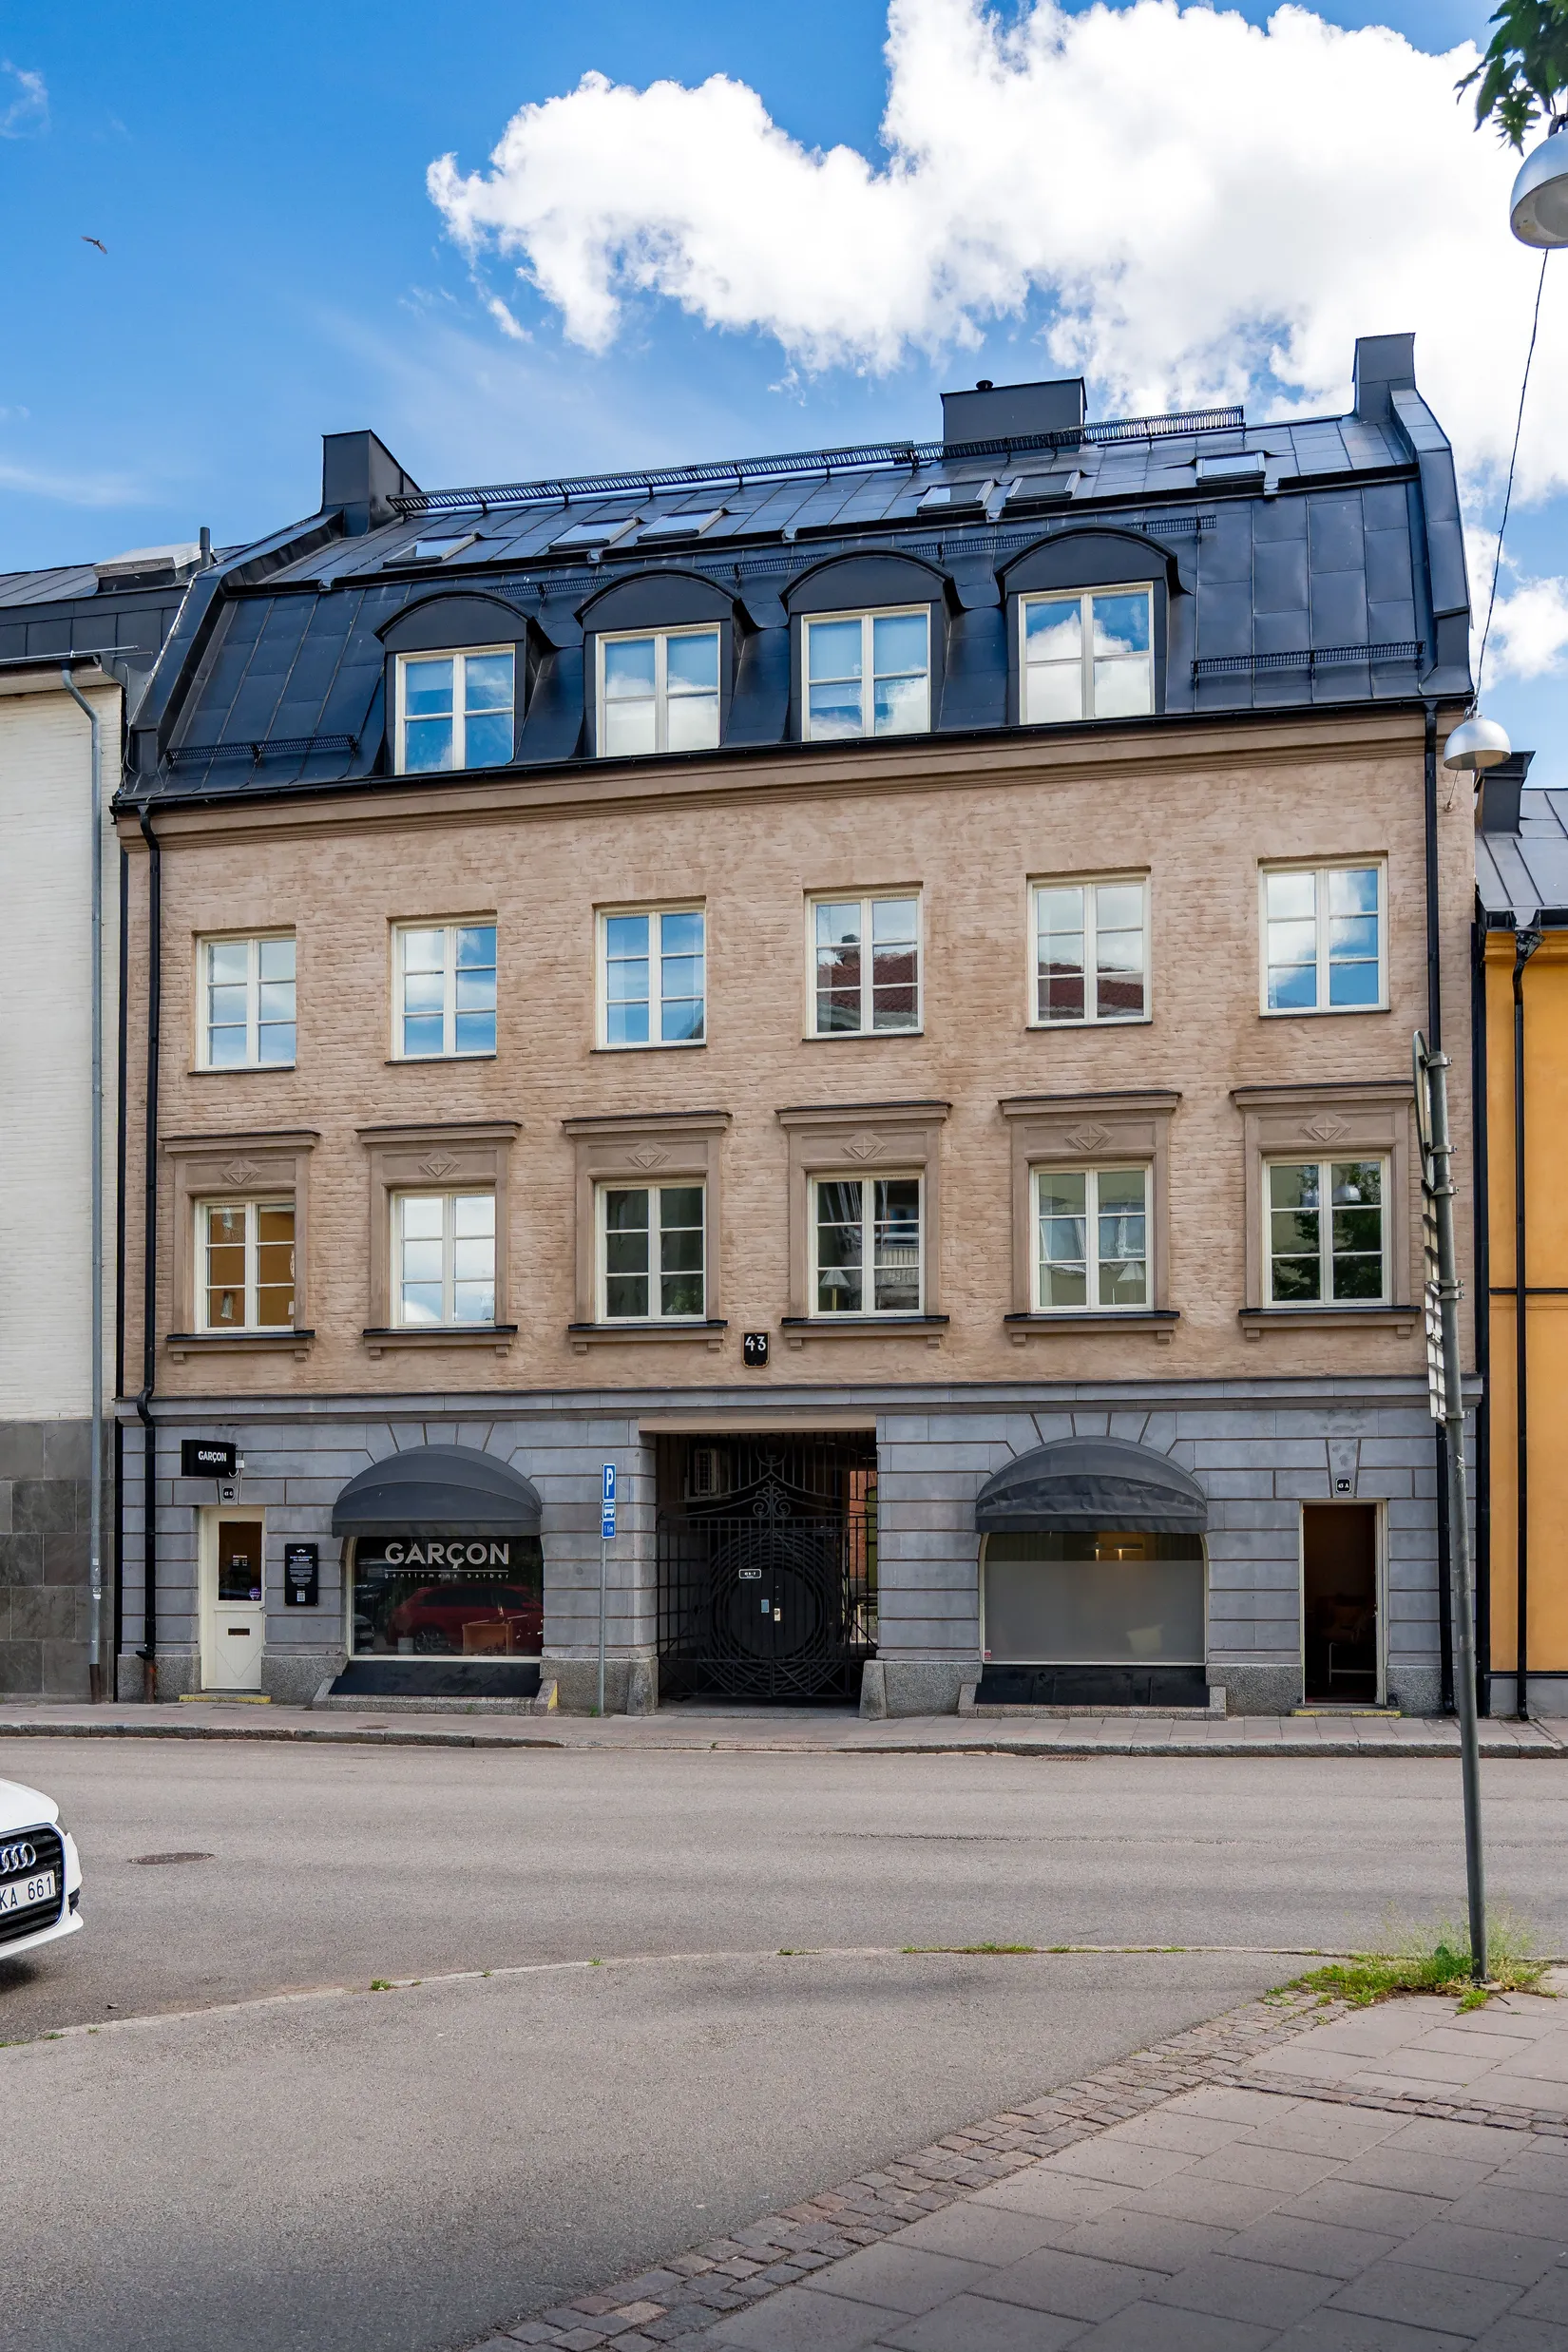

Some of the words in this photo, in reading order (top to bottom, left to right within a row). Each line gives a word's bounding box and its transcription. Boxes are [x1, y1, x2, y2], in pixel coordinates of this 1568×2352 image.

[745, 1335, 767, 1351] 43
[198, 1450, 227, 1463] GARÇON
[606, 1467, 614, 1497] P
[384, 1542, 509, 1569] GARÇON
[0, 1887, 18, 1910] KA
[28, 1876, 51, 1901] 661
